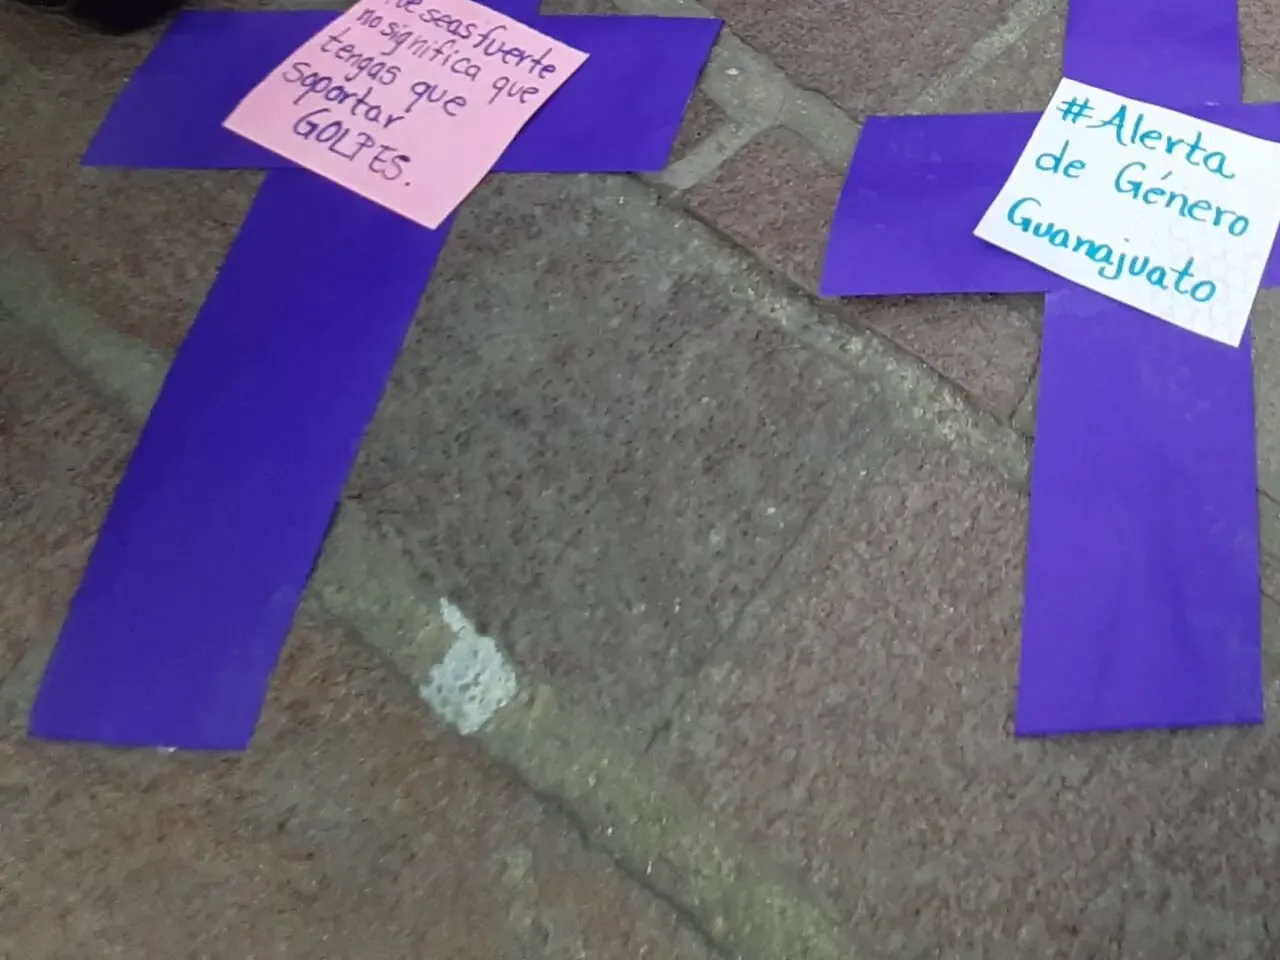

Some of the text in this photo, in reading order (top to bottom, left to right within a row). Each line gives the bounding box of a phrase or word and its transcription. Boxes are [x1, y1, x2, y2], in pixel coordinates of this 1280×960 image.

[320, 27, 468, 117] tengas que
[380, 21, 481, 82] significa
[489, 76, 540, 105] que
[419, 8, 478, 40] seas
[473, 24, 557, 80] fuerte
[1056, 96, 1236, 179] #Alerta
[1035, 139, 1250, 237] de Género
[1007, 197, 1217, 303] Guanajuato
